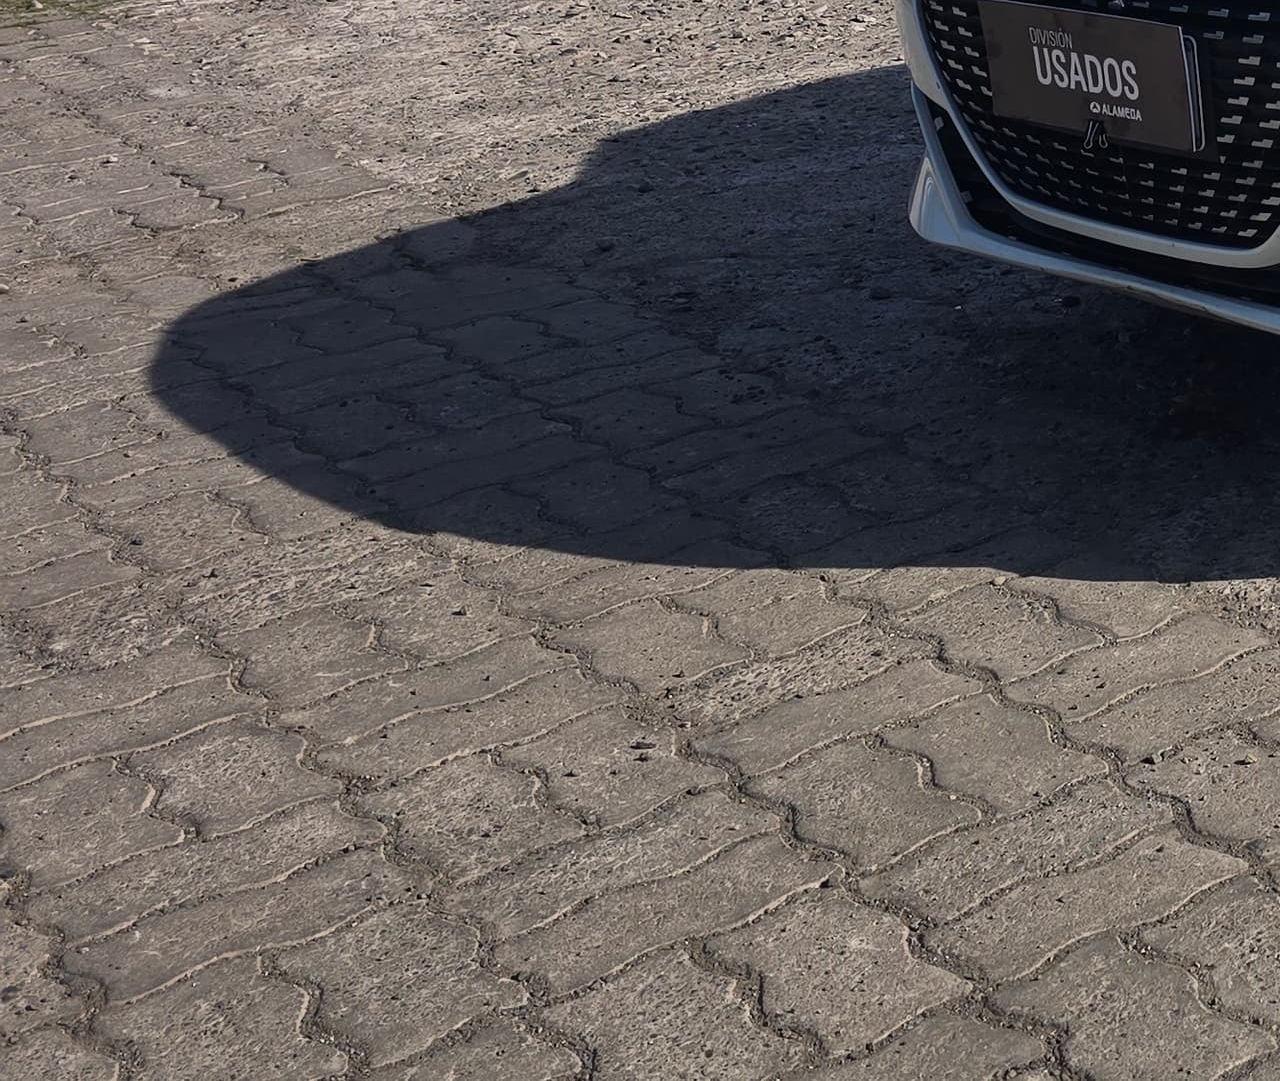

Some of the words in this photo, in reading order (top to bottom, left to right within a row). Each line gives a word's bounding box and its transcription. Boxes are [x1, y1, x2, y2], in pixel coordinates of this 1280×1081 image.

[1028, 26, 1073, 50] DIVISIÓN
[1033, 45, 1140, 101] USADOS
[1101, 103, 1142, 122] ALAMEDA
